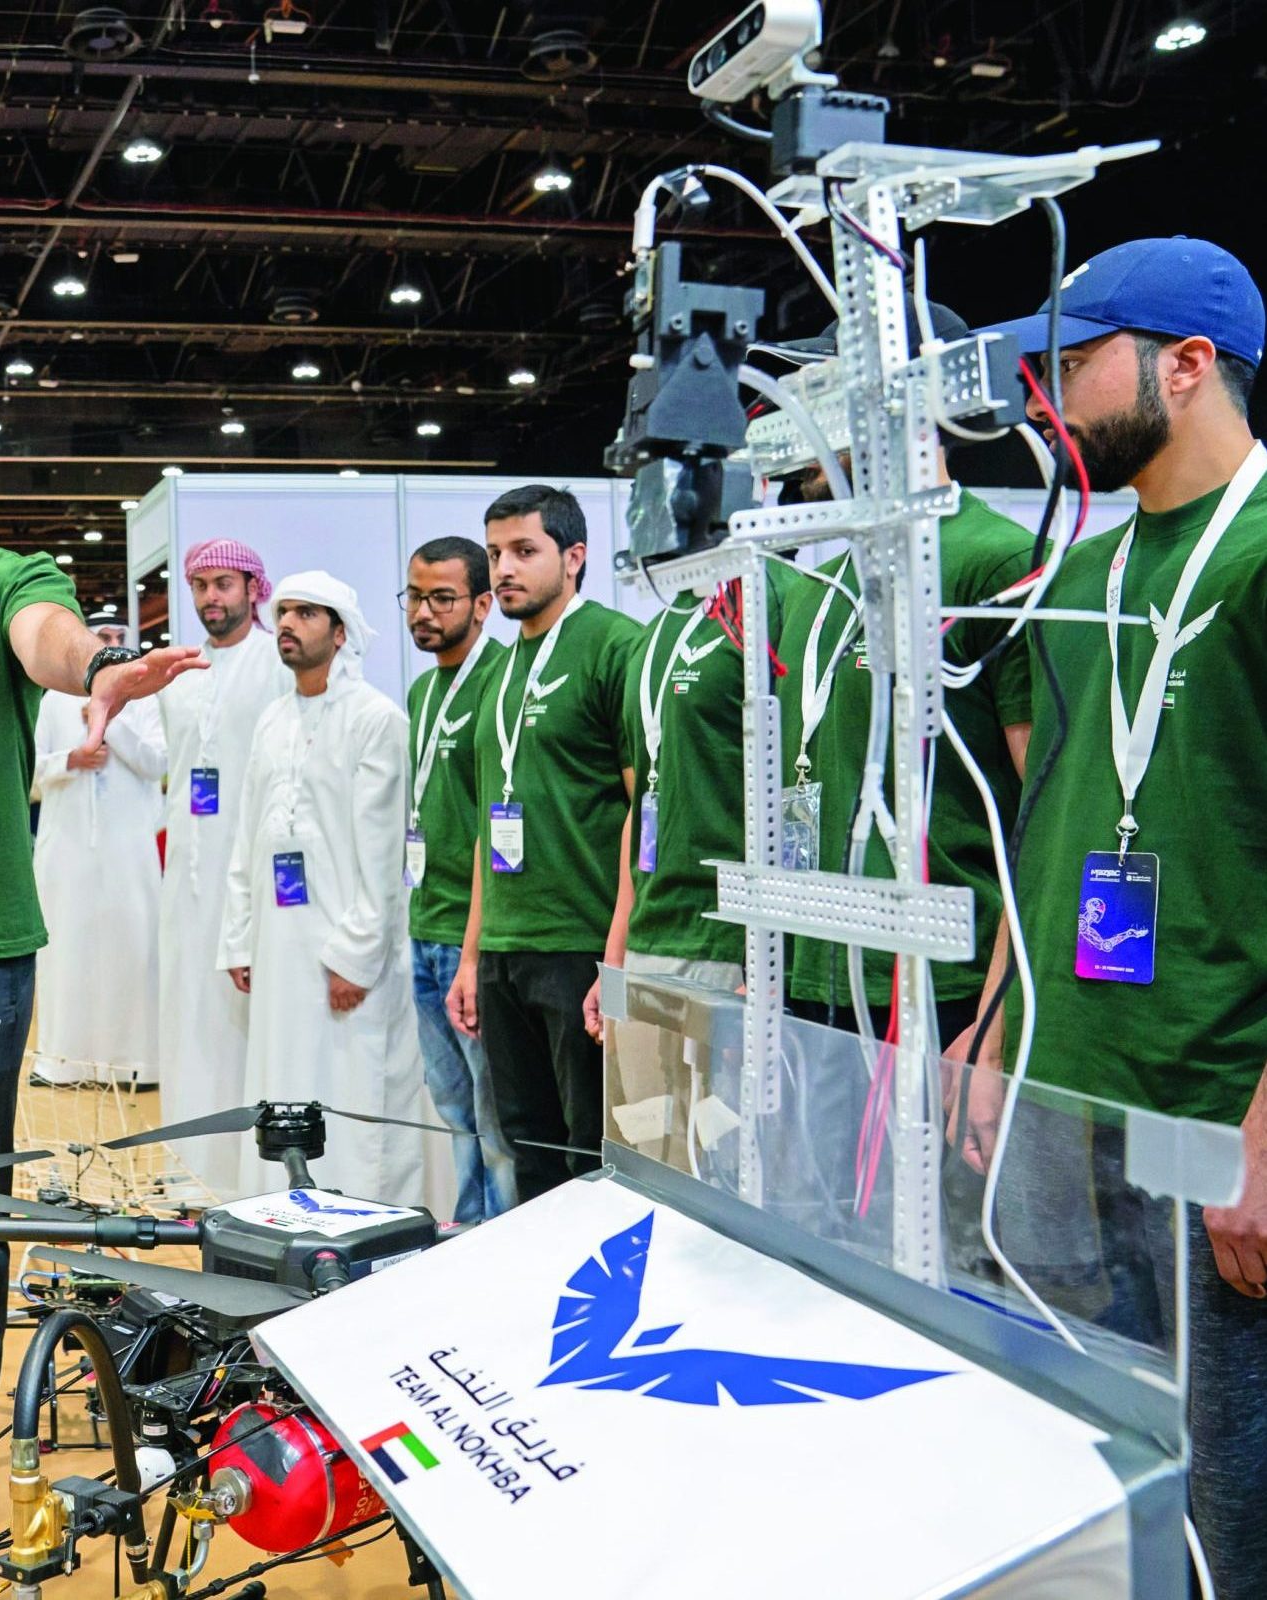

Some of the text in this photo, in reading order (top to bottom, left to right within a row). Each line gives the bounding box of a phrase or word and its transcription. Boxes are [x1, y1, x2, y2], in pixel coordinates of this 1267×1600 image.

[389, 1365, 531, 1504] TEAM AL NOKHBA
[429, 1346, 585, 1481] فريق النخبة
